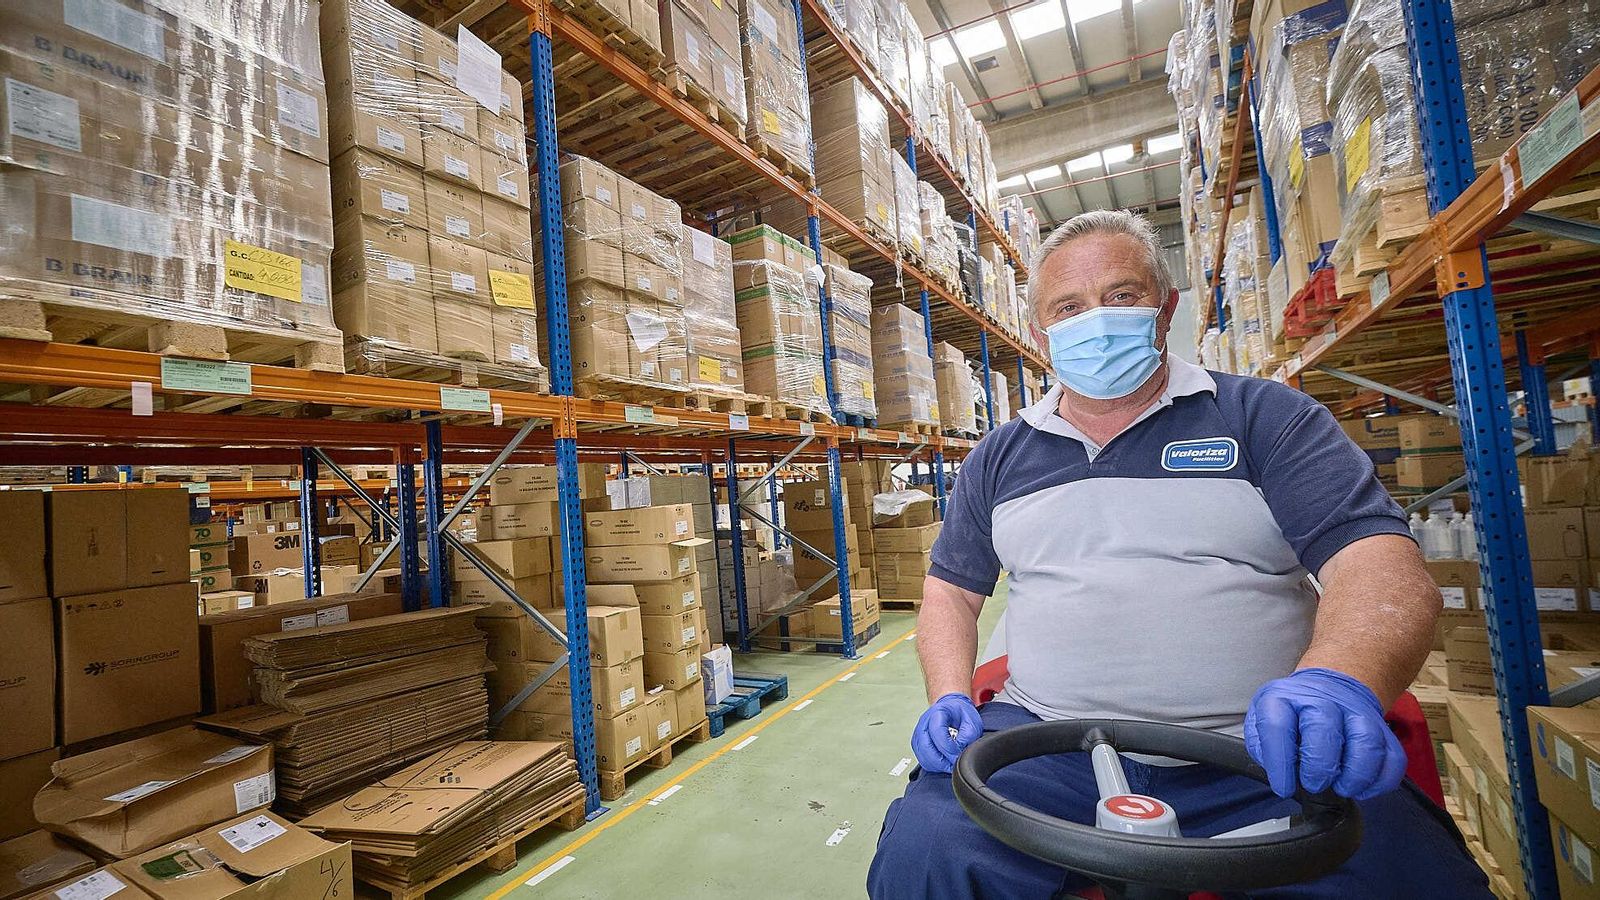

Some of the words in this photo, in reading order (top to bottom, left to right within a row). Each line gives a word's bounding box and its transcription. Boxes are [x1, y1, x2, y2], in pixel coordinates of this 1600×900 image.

[230, 250, 251, 261] G.C.
[45, 257, 64, 272] B
[1171, 447, 1229, 458] Valoriza
[194, 527, 211, 539] 70
[274, 534, 300, 550] 3M
[254, 578, 269, 594] 3M
